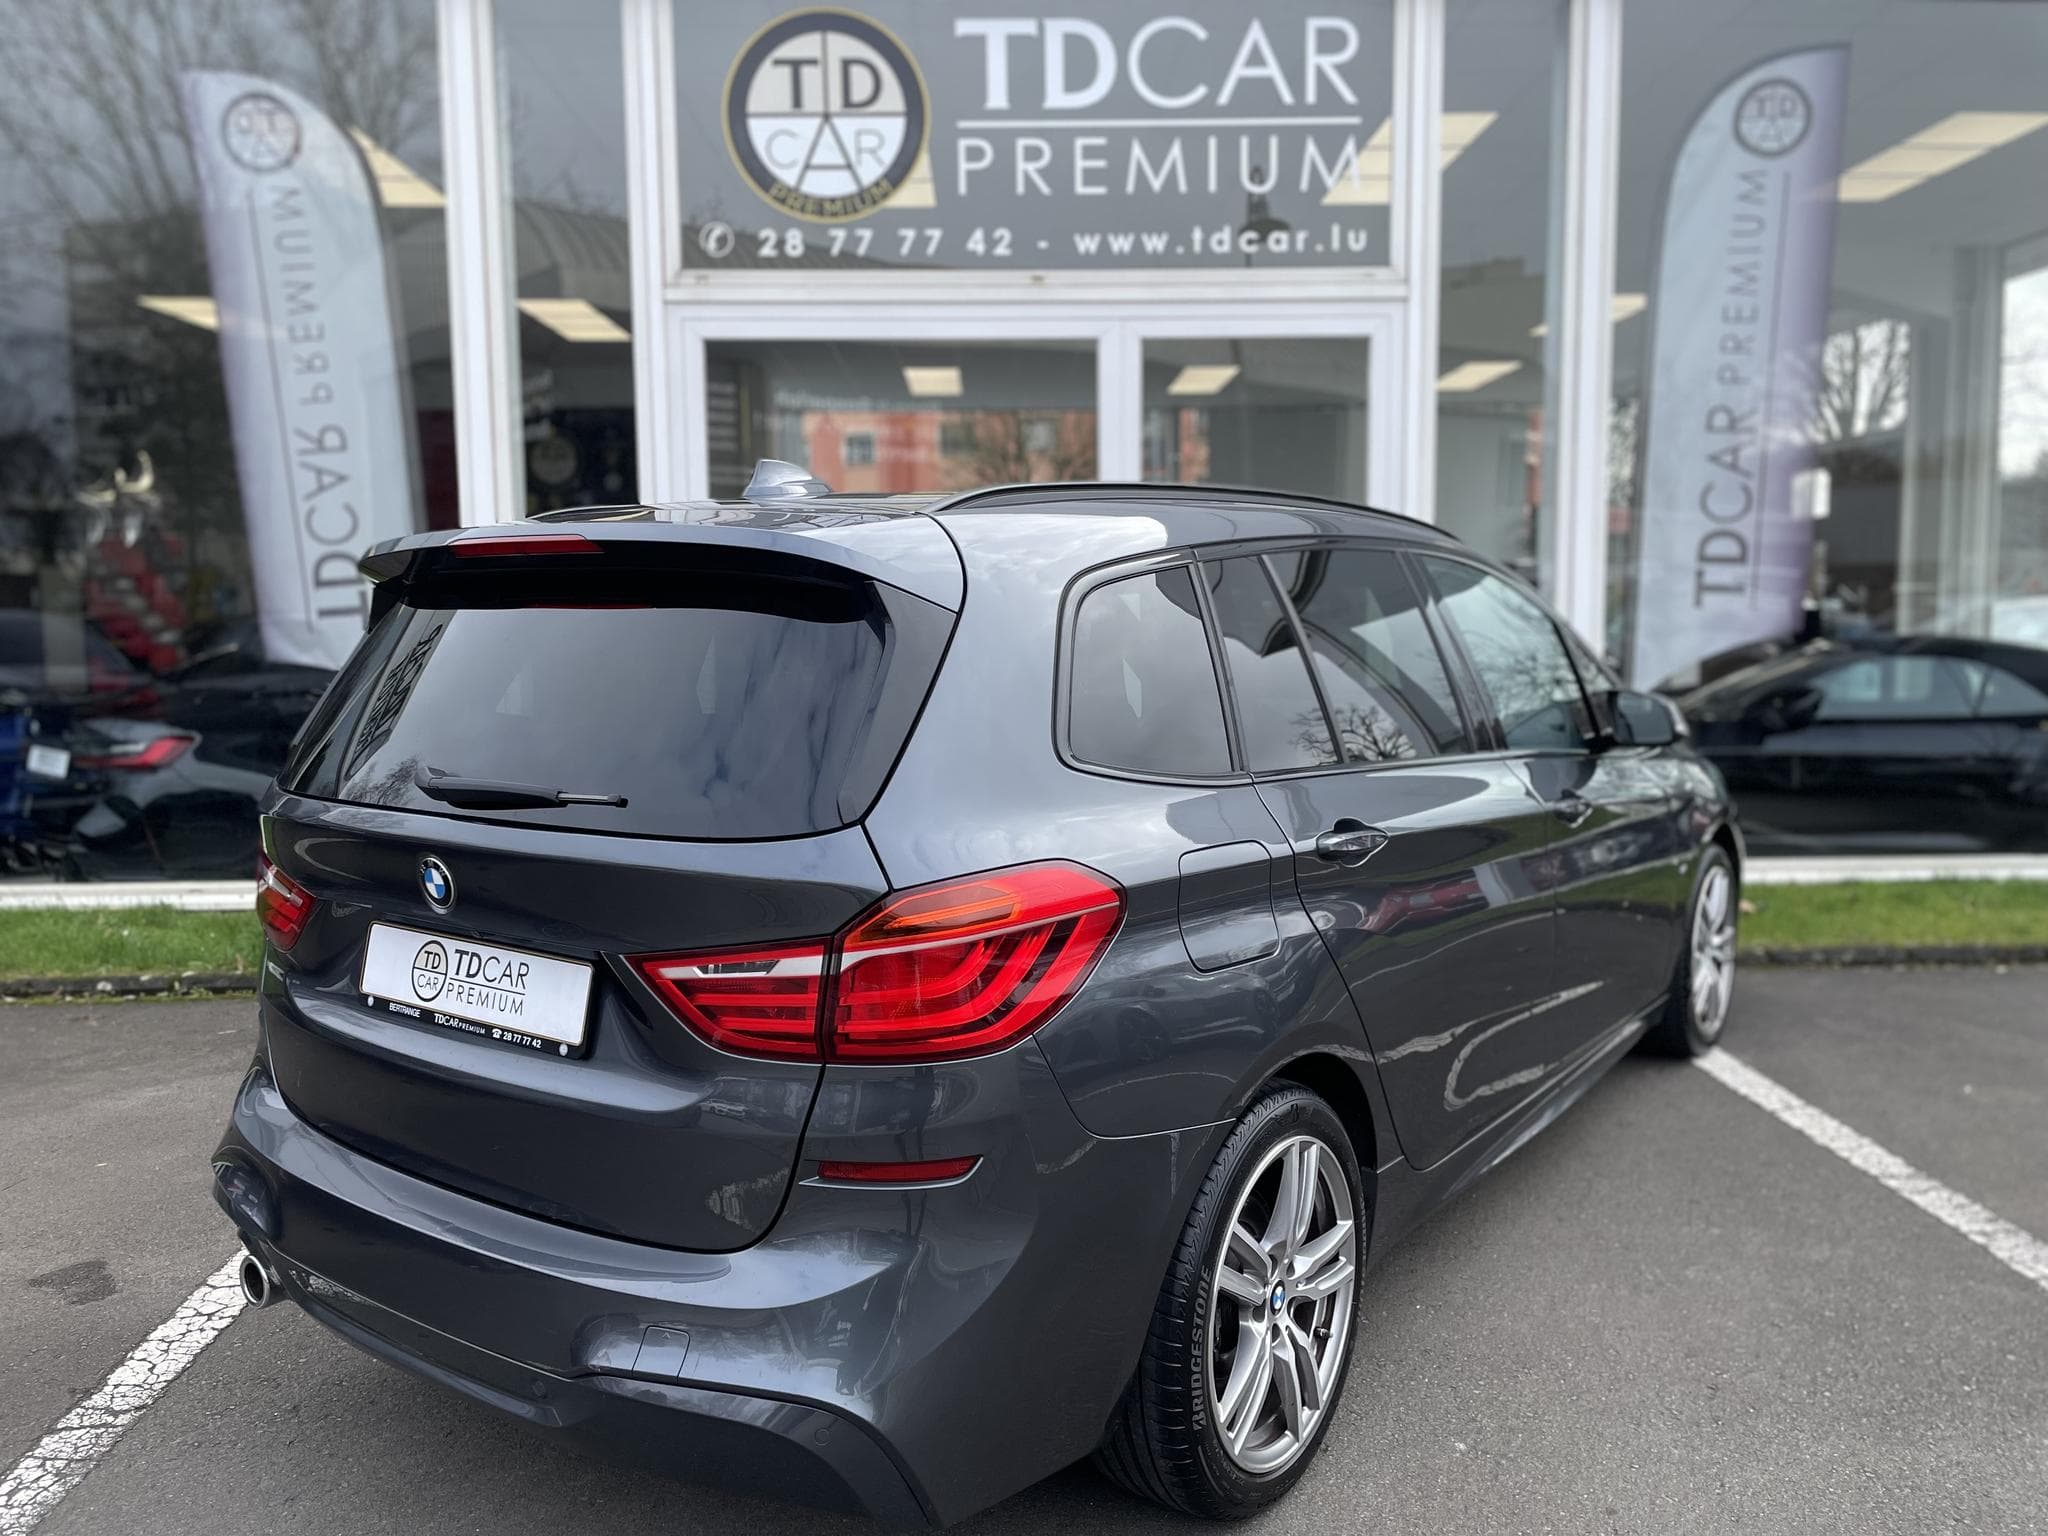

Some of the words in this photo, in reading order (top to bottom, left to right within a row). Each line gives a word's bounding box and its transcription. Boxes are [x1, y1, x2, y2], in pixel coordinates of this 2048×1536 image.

[953, 15, 1361, 111] TDCAR
[764, 117, 886, 191] CAR
[957, 134, 1361, 196] PREMIUM
[768, 177, 894, 218] PREMIUM
[757, 227, 805, 258] 28
[827, 227, 874, 257] 77
[897, 227, 943, 257] 77
[965, 226, 1012, 257] 42
[1073, 223, 1367, 255] www.tdcar.lu
[1715, 168, 1770, 387] PREMIUM
[1693, 402, 1758, 608] TDCAR
[417, 973, 439, 991] CAR
[424, 950, 441, 970] TD
[454, 948, 530, 990] TDCAR
[446, 982, 524, 1016] PREMIUM
[389, 1002, 421, 1018] BERTRANGE
[503, 1031, 512, 1041] 28
[513, 1033, 521, 1044] 77
[522, 1036, 531, 1046] 77
[532, 1038, 542, 1048] 42
[1191, 1265, 1212, 1431] BRIDGESTONE
